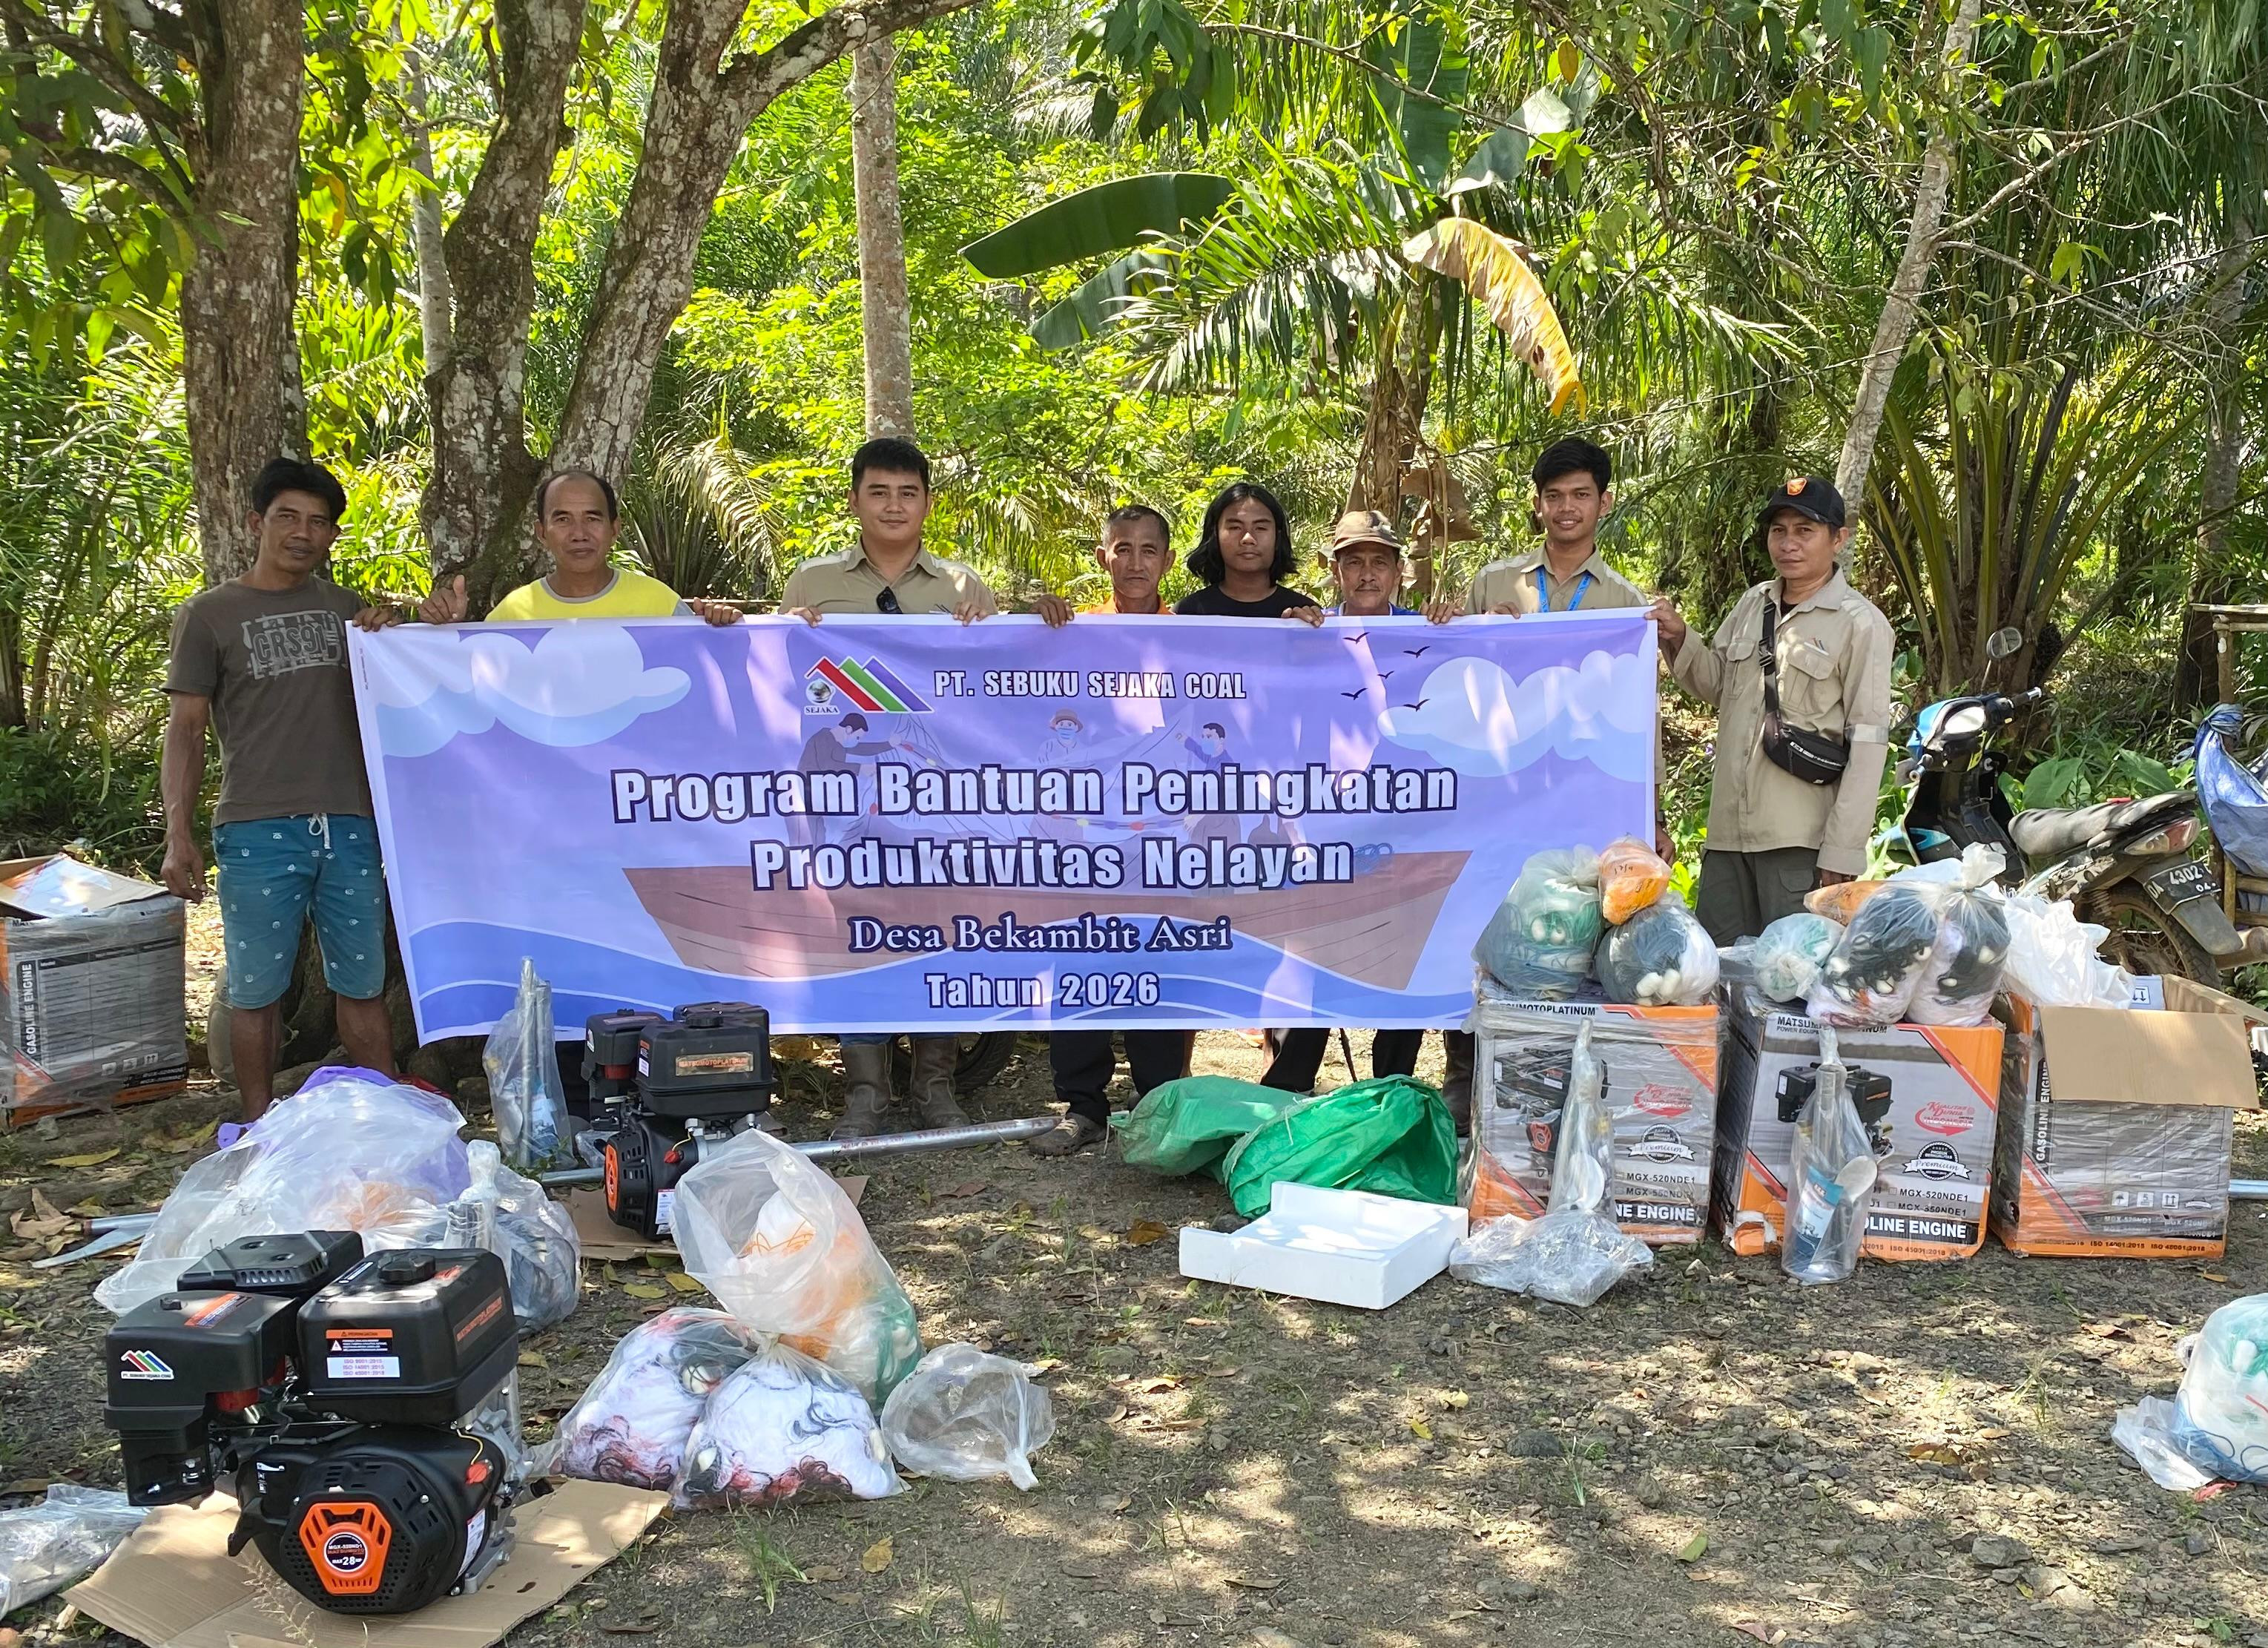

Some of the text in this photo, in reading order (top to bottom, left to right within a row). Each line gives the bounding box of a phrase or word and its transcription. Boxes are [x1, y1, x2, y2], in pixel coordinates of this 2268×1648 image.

[934, 670, 1247, 699] PT. SEBUKU SEJAKA COAL
[610, 762, 1458, 823] Program Bantuan Peningkatan
[751, 836, 1354, 891] Produktivitas Nelayan
[2169, 865, 2203, 885] 4302
[849, 912, 1233, 953] Desa Bekambit Asri
[924, 972, 1161, 1009] Tahun 2026
[22, 963, 37, 1054] GASOLINE ENGINE
[2036, 1106, 2049, 1161] GASOLINE
[1641, 1142, 1685, 1153] Premium
[1915, 1159, 1959, 1172] Premium
[1626, 1173, 1695, 1184] MGX-520NDE1
[1899, 1188, 1969, 1203] MGX-520NDE1
[1637, 1204, 1695, 1222] ENGINE
[1909, 1221, 1966, 1239] ENGINE
[343, 1556, 356, 1566] 28
